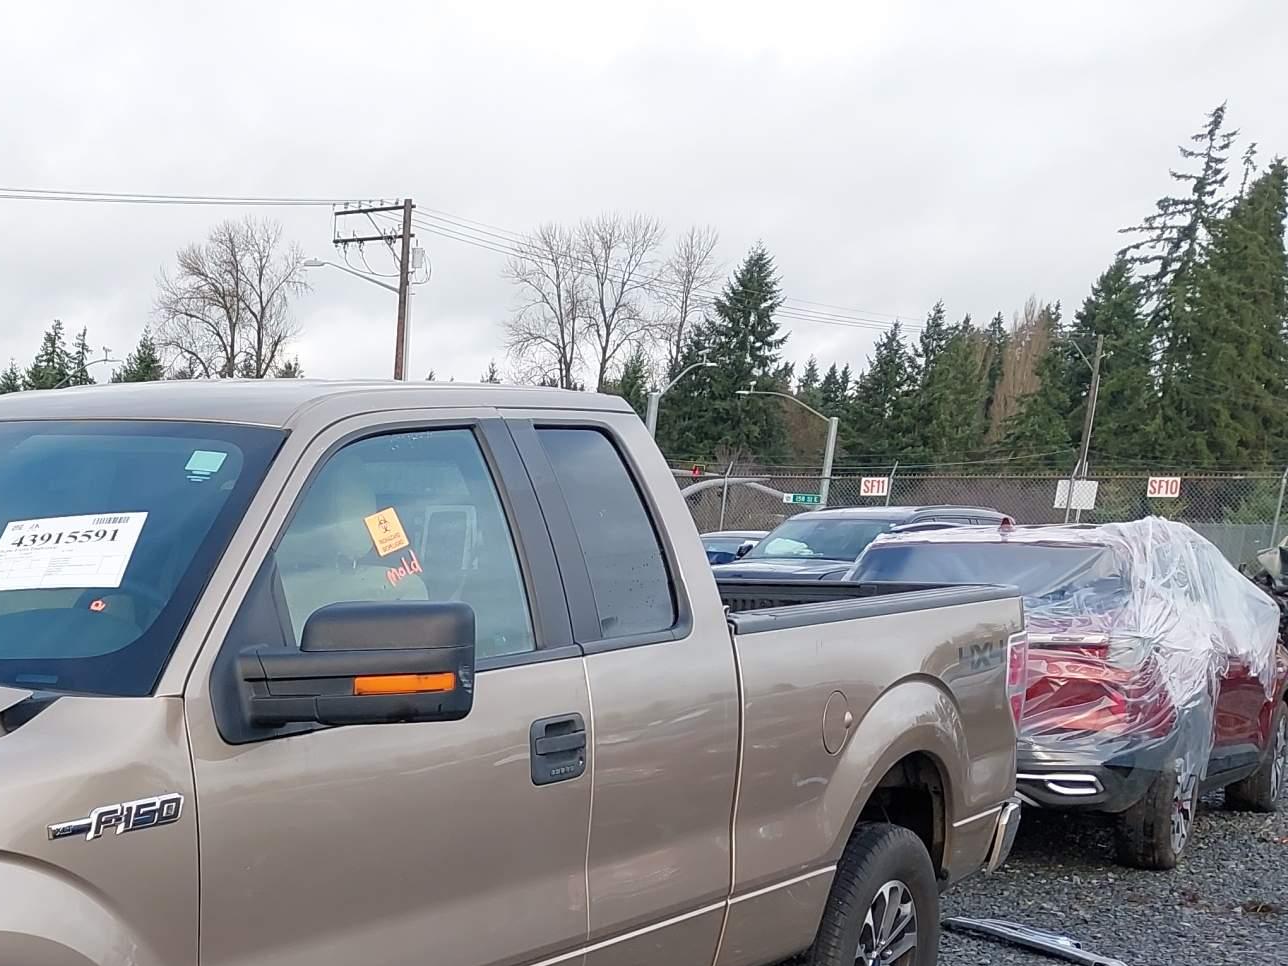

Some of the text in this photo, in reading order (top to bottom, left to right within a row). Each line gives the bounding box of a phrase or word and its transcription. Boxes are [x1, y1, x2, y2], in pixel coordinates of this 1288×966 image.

[863, 479, 886, 494] SF11
[1149, 479, 1179, 495] SF10
[11, 528, 119, 548] 43915591
